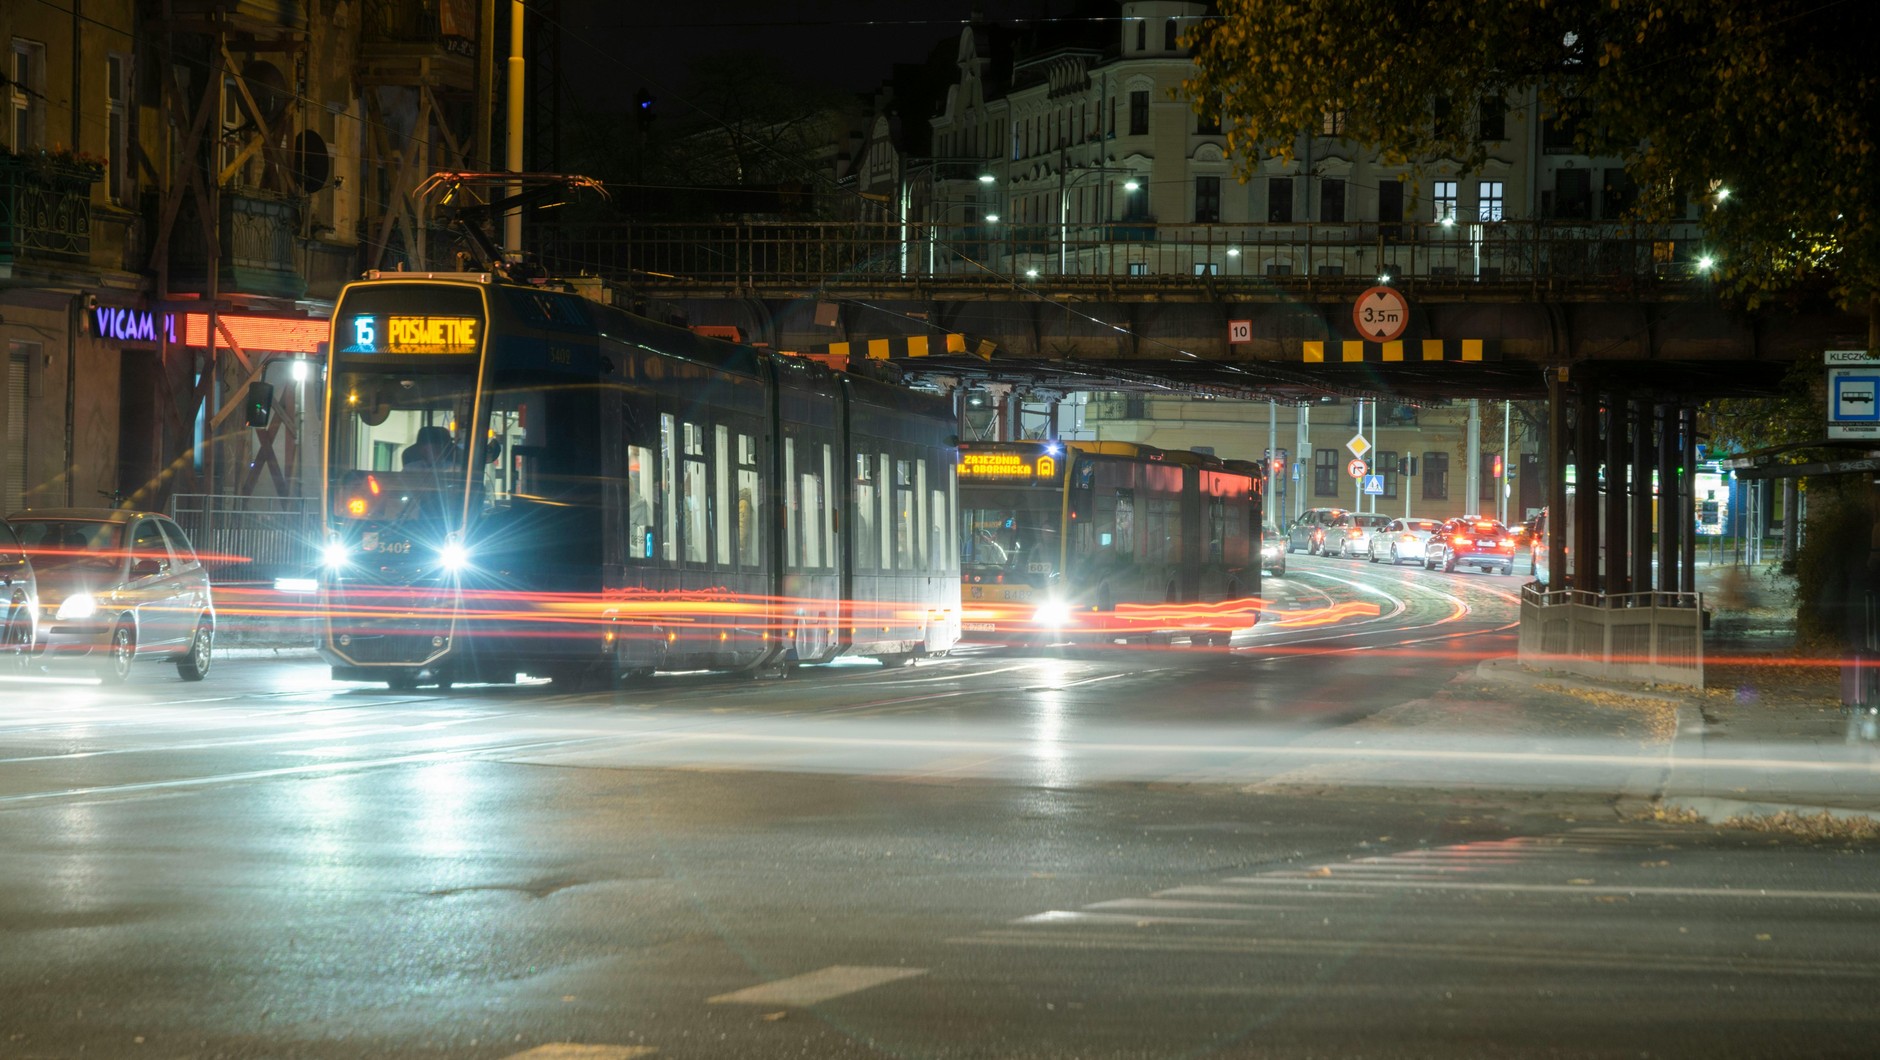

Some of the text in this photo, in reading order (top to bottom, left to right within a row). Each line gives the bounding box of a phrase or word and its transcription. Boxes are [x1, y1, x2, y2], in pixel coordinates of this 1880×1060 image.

[355, 317, 374, 344] 15
[1233, 326, 1247, 337] 10
[964, 455, 1021, 464] ZAJEZDNIA
[973, 464, 1032, 474] OBORNICKA
[379, 542, 411, 553] 3402
